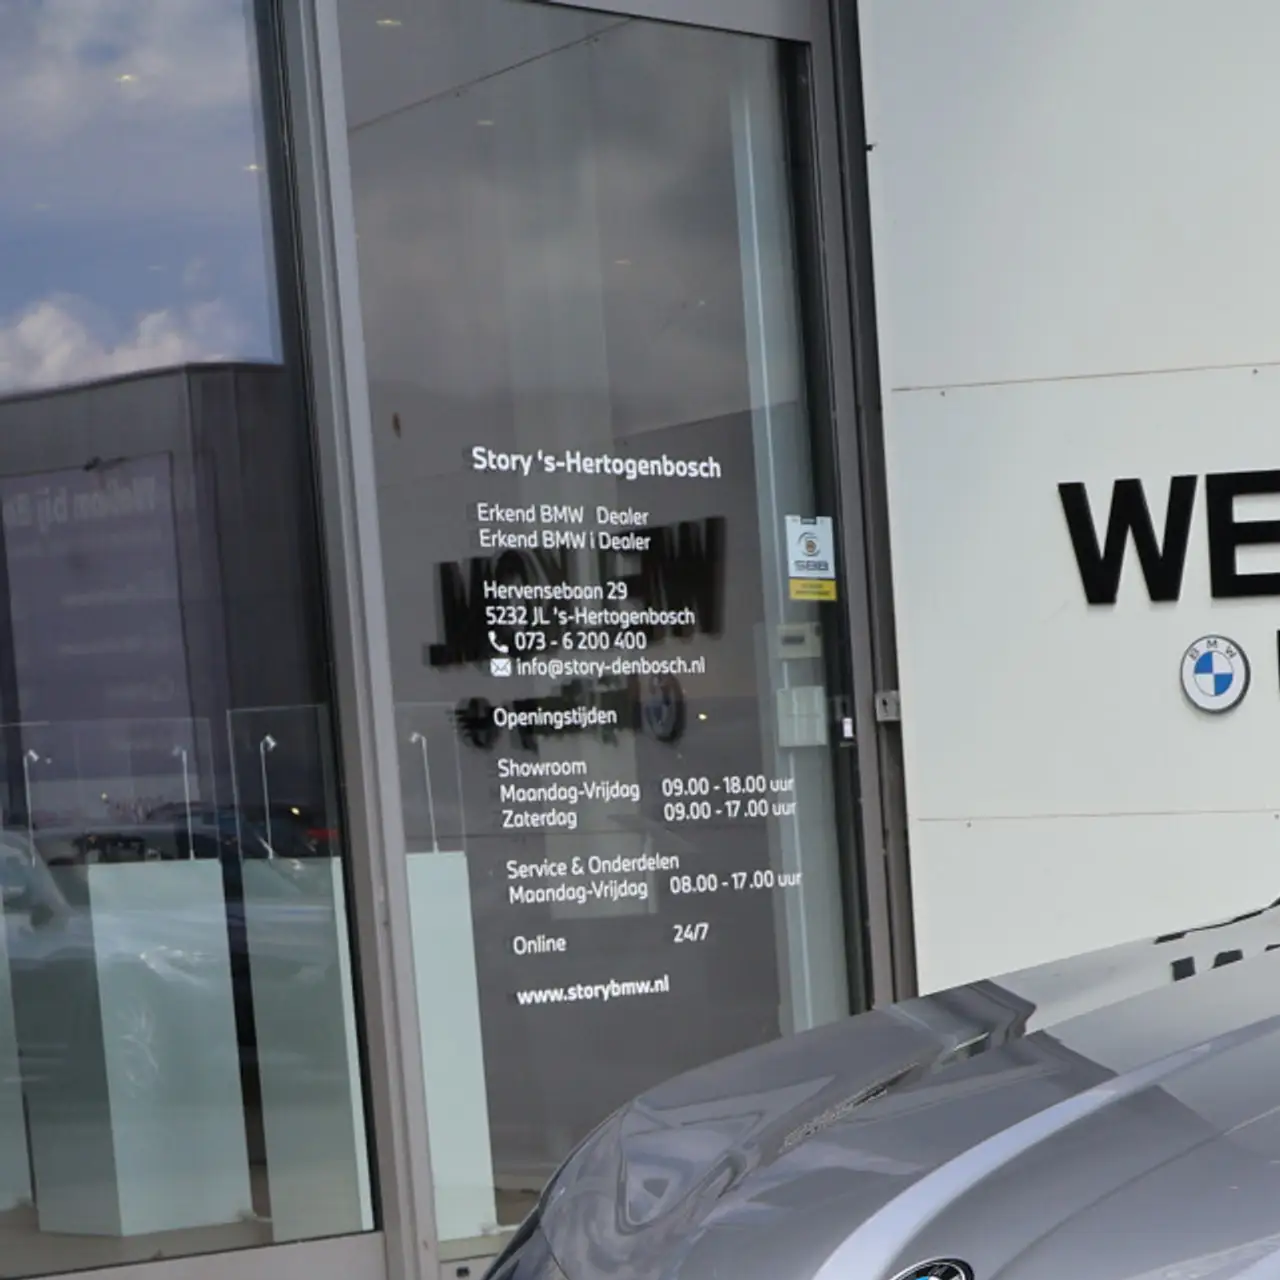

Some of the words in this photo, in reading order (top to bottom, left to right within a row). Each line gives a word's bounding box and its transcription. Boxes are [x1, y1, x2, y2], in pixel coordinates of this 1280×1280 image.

[472, 447, 533, 476] Story
[537, 450, 721, 480] 's-Hertogenbosch
[477, 502, 536, 523] Erkend
[540, 504, 583, 524] BMW
[596, 506, 649, 525] Dealer
[479, 528, 539, 548] Erkend
[542, 530, 586, 551] BMW
[590, 531, 595, 549] i
[598, 531, 651, 551] Dealer
[483, 580, 603, 602] Hervensebaan
[606, 581, 628, 601] 29
[485, 604, 528, 628] 5232
[531, 603, 551, 627] JL
[553, 606, 695, 630] 's-Hertogenbosch
[514, 630, 547, 651] 073
[562, 631, 573, 650] 6
[576, 631, 610, 650] 200
[614, 631, 647, 649] 400
[516, 656, 705, 679] info@story-denbosch.nl
[493, 706, 617, 730] Openingstijden
[498, 758, 587, 778] Showroom
[500, 781, 640, 804] Maandag-Vrijdag
[662, 777, 709, 797] 09.00
[723, 774, 767, 794] 18.00
[770, 775, 794, 792] uur
[502, 808, 577, 830] Zaterdag
[664, 801, 711, 821] 09.00
[772, 802, 796, 816] uur
[506, 858, 567, 878] Service
[571, 856, 585, 875] &
[588, 852, 679, 874] Onderdelen
[508, 877, 648, 904] Maandag-Vrijdag
[670, 874, 718, 894] 08.00
[778, 872, 802, 887] uur
[513, 934, 566, 955] Online
[673, 922, 709, 943] 24/7
[517, 974, 669, 1005] www.storybmw.nl
